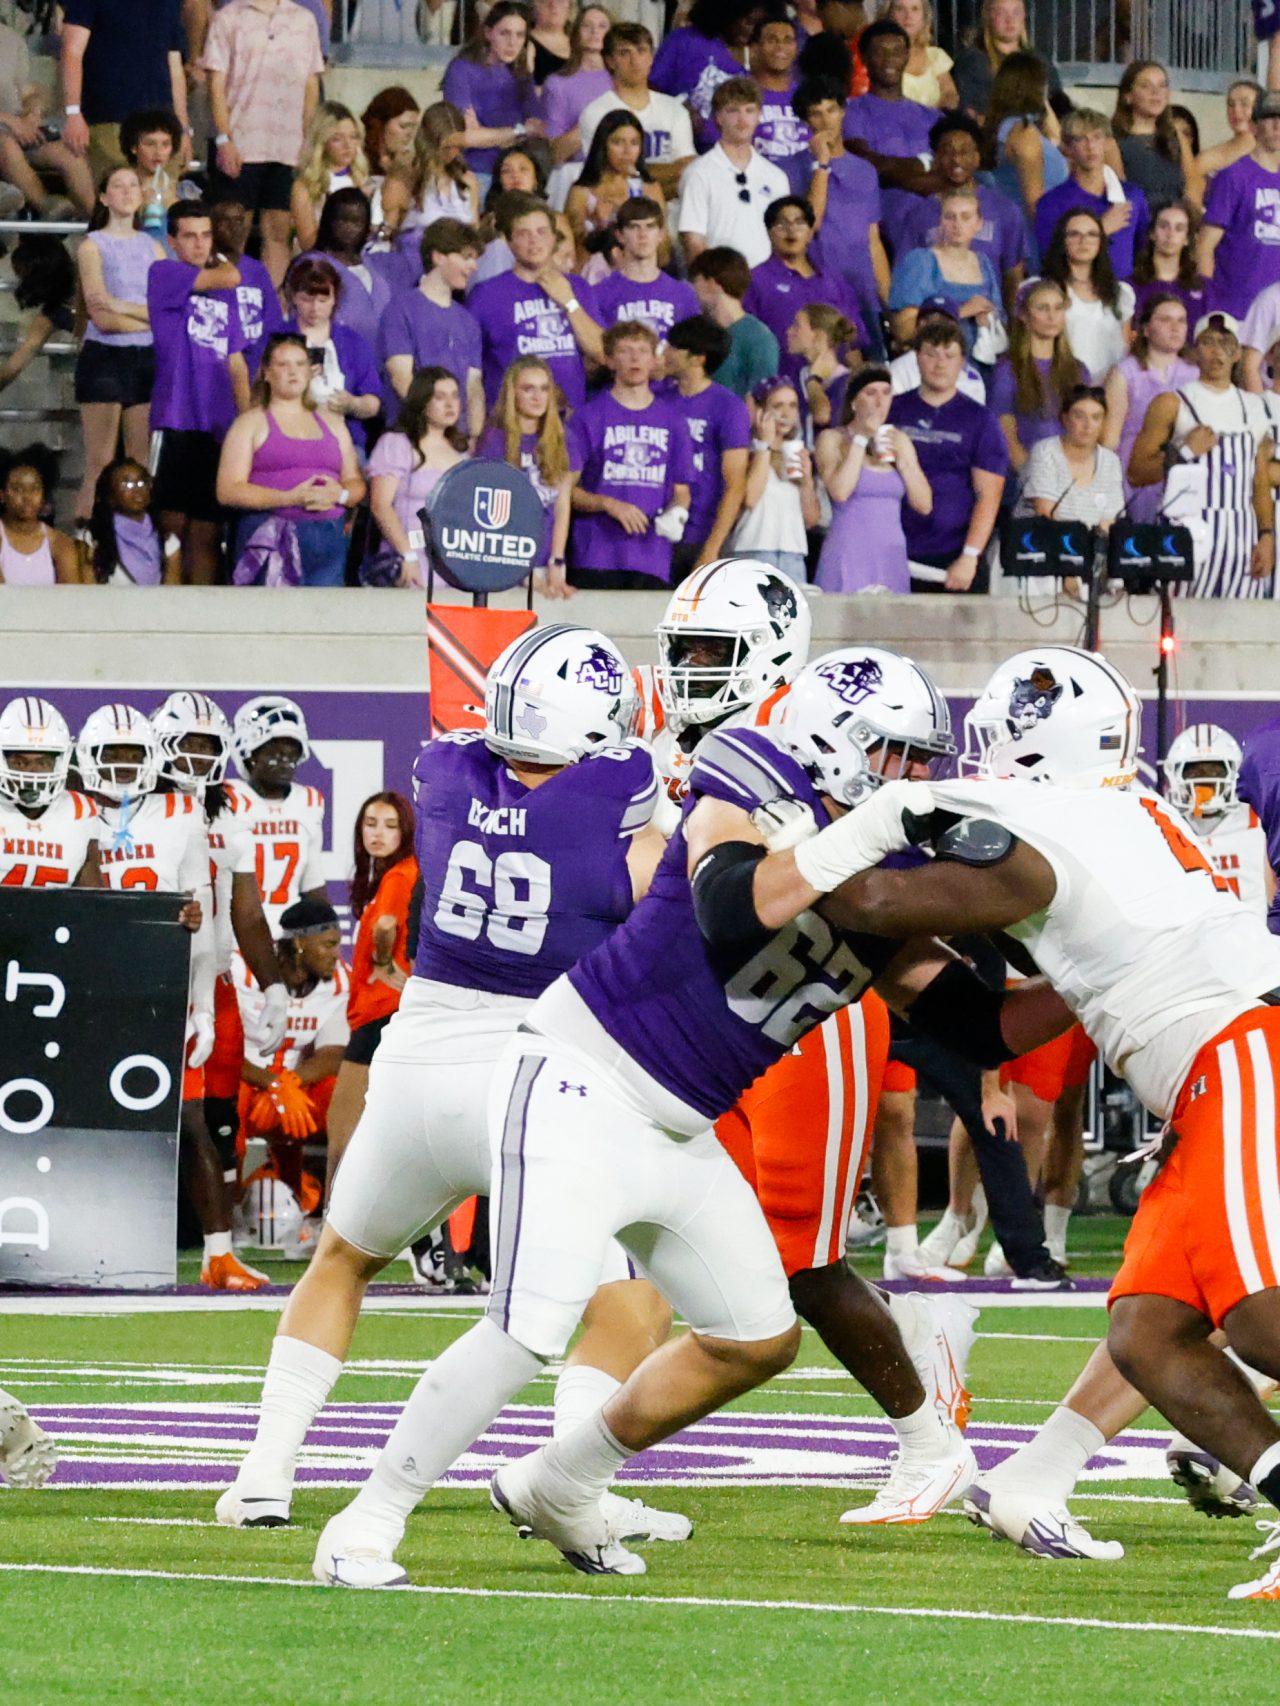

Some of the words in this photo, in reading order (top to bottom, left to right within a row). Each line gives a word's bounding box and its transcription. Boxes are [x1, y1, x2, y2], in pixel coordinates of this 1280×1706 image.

[603, 425, 669, 452] ABILENE
[603, 460, 667, 483] CHRISTIAN
[442, 527, 537, 558] UNITED
[446, 551, 481, 561] ATHLETIC
[483, 555, 530, 567] CONFERENCE
[576, 660, 624, 696] ACU
[3, 838, 63, 859] MERCER
[255, 842, 299, 904] 17
[433, 840, 552, 956] 68
[724, 908, 872, 1048] 62
